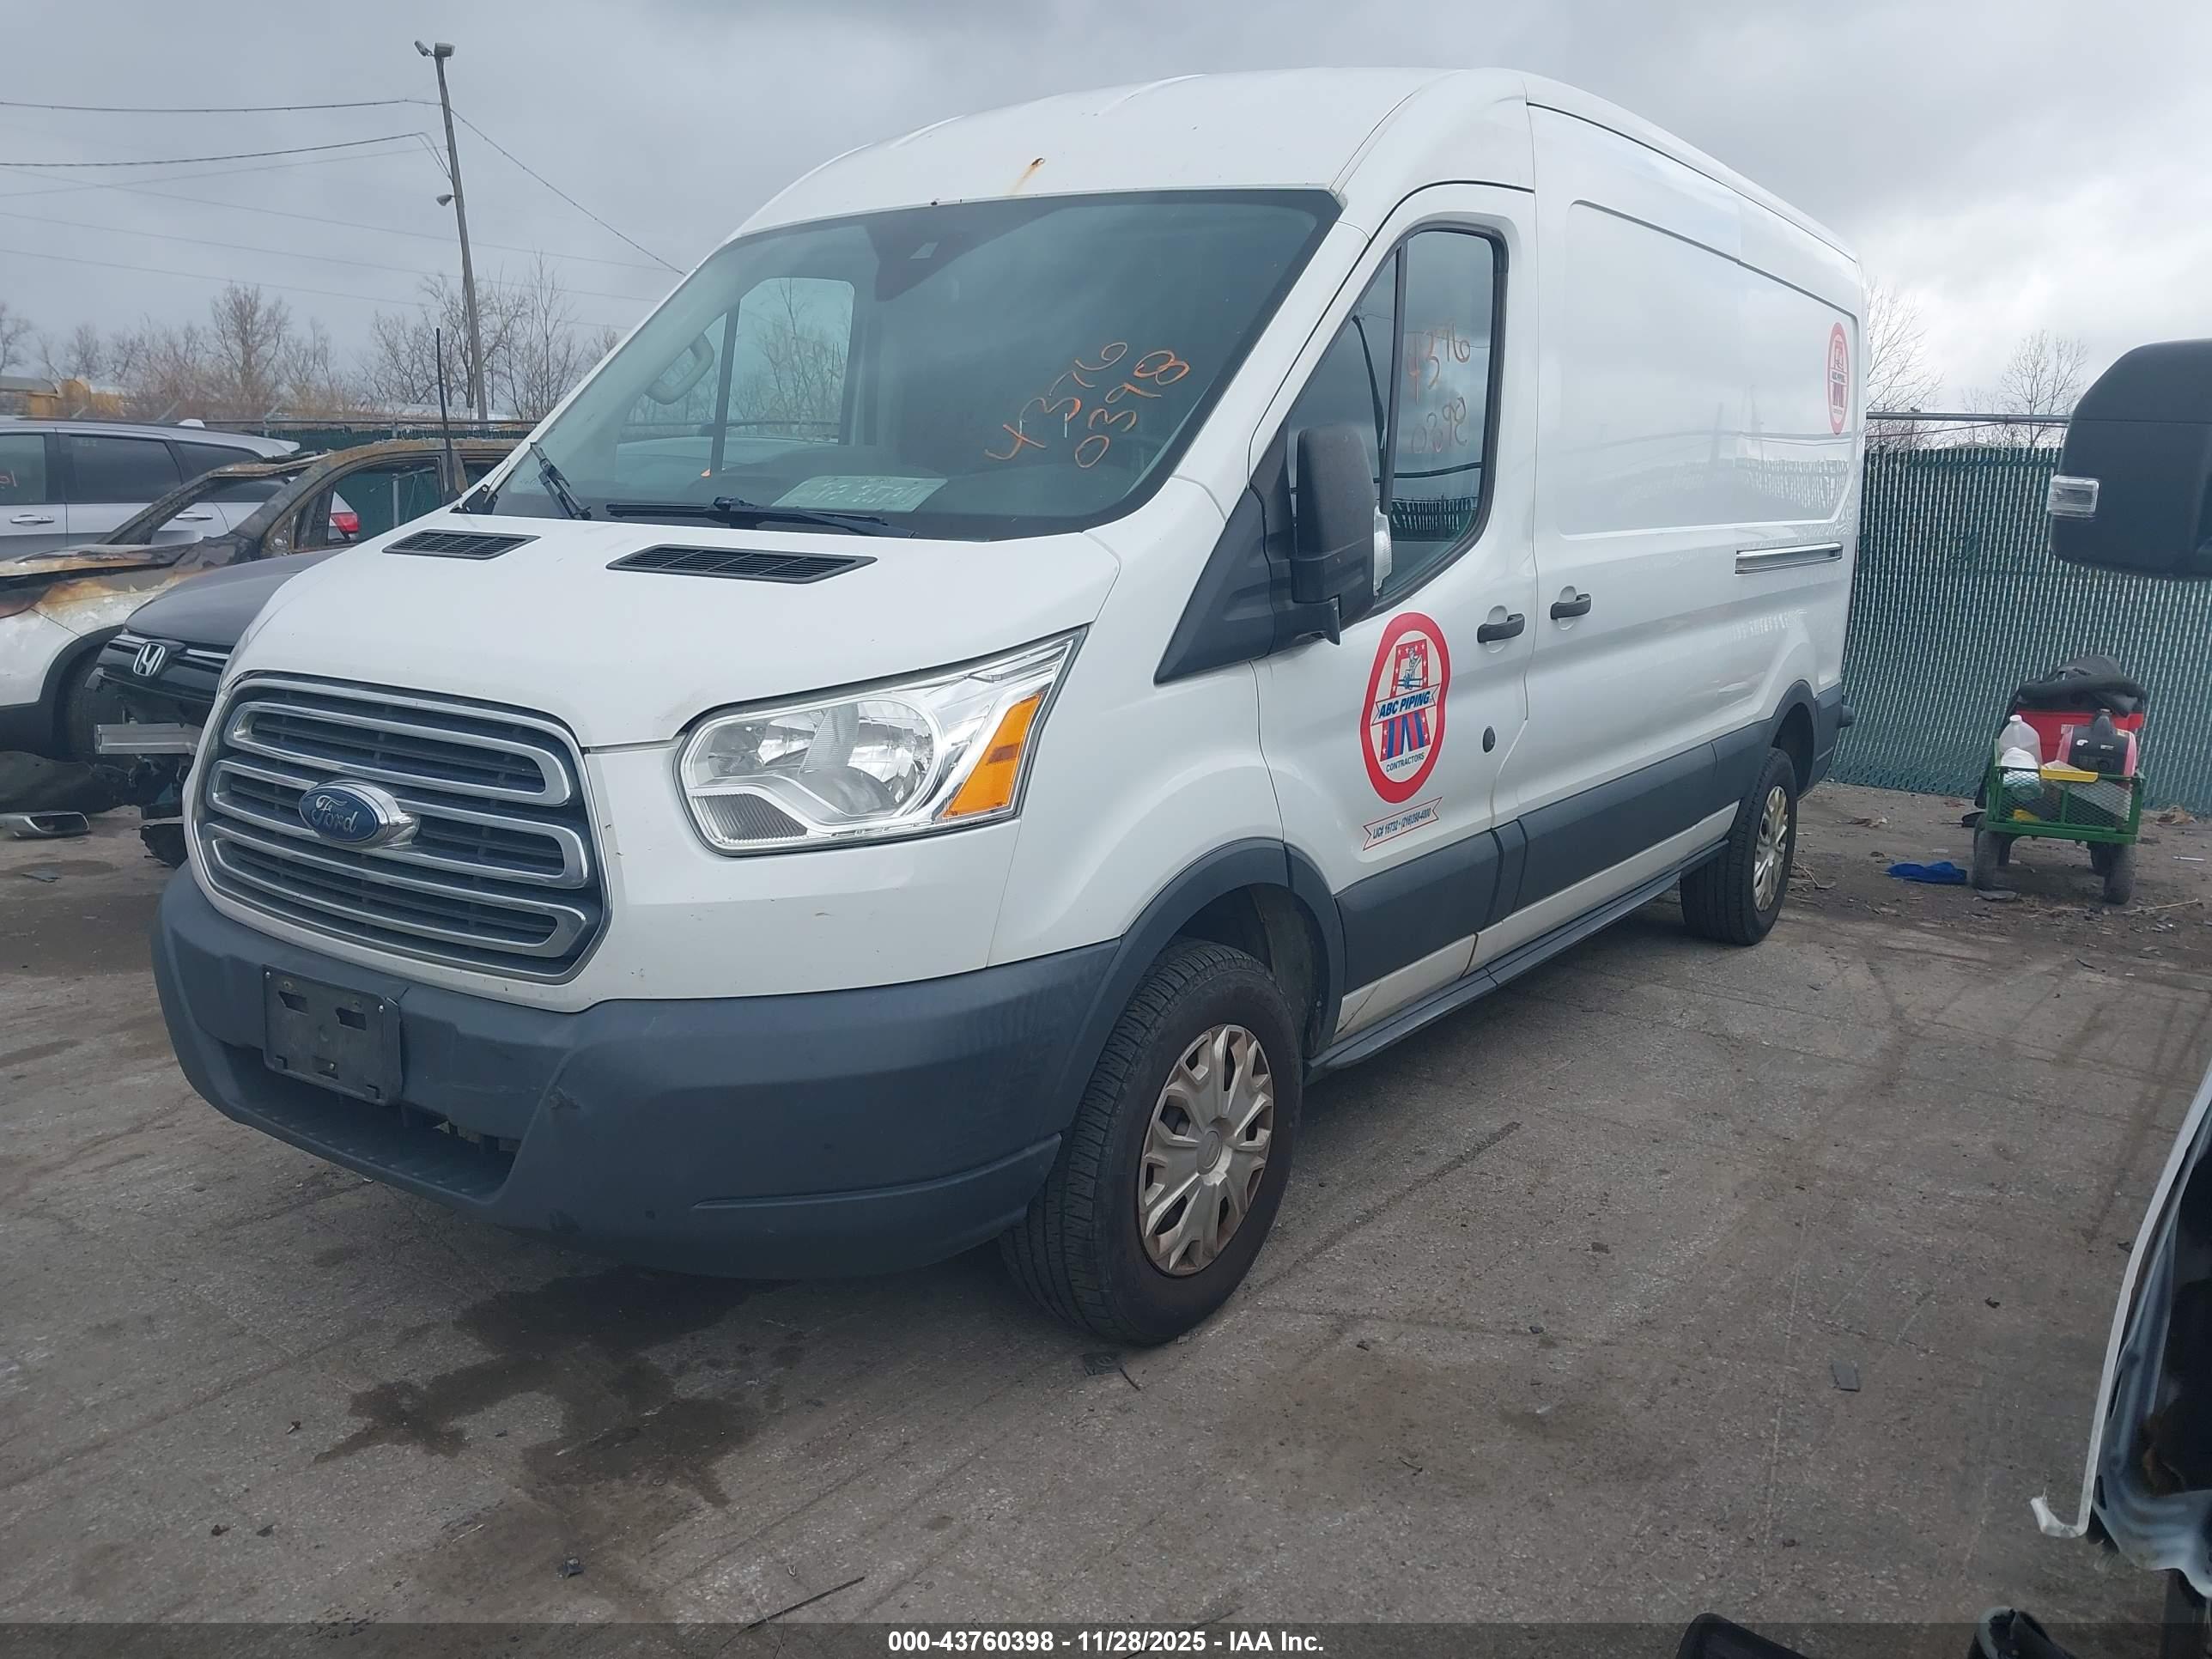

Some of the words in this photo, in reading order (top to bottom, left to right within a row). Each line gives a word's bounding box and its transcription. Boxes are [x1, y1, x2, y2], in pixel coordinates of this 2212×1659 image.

[1074, 349, 1191, 469] 0398
[1378, 700, 1400, 720] ABC
[1400, 690, 1430, 712] PIPING
[1386, 752, 1425, 772] CONTRACTORS
[311, 794, 359, 834] Ford
